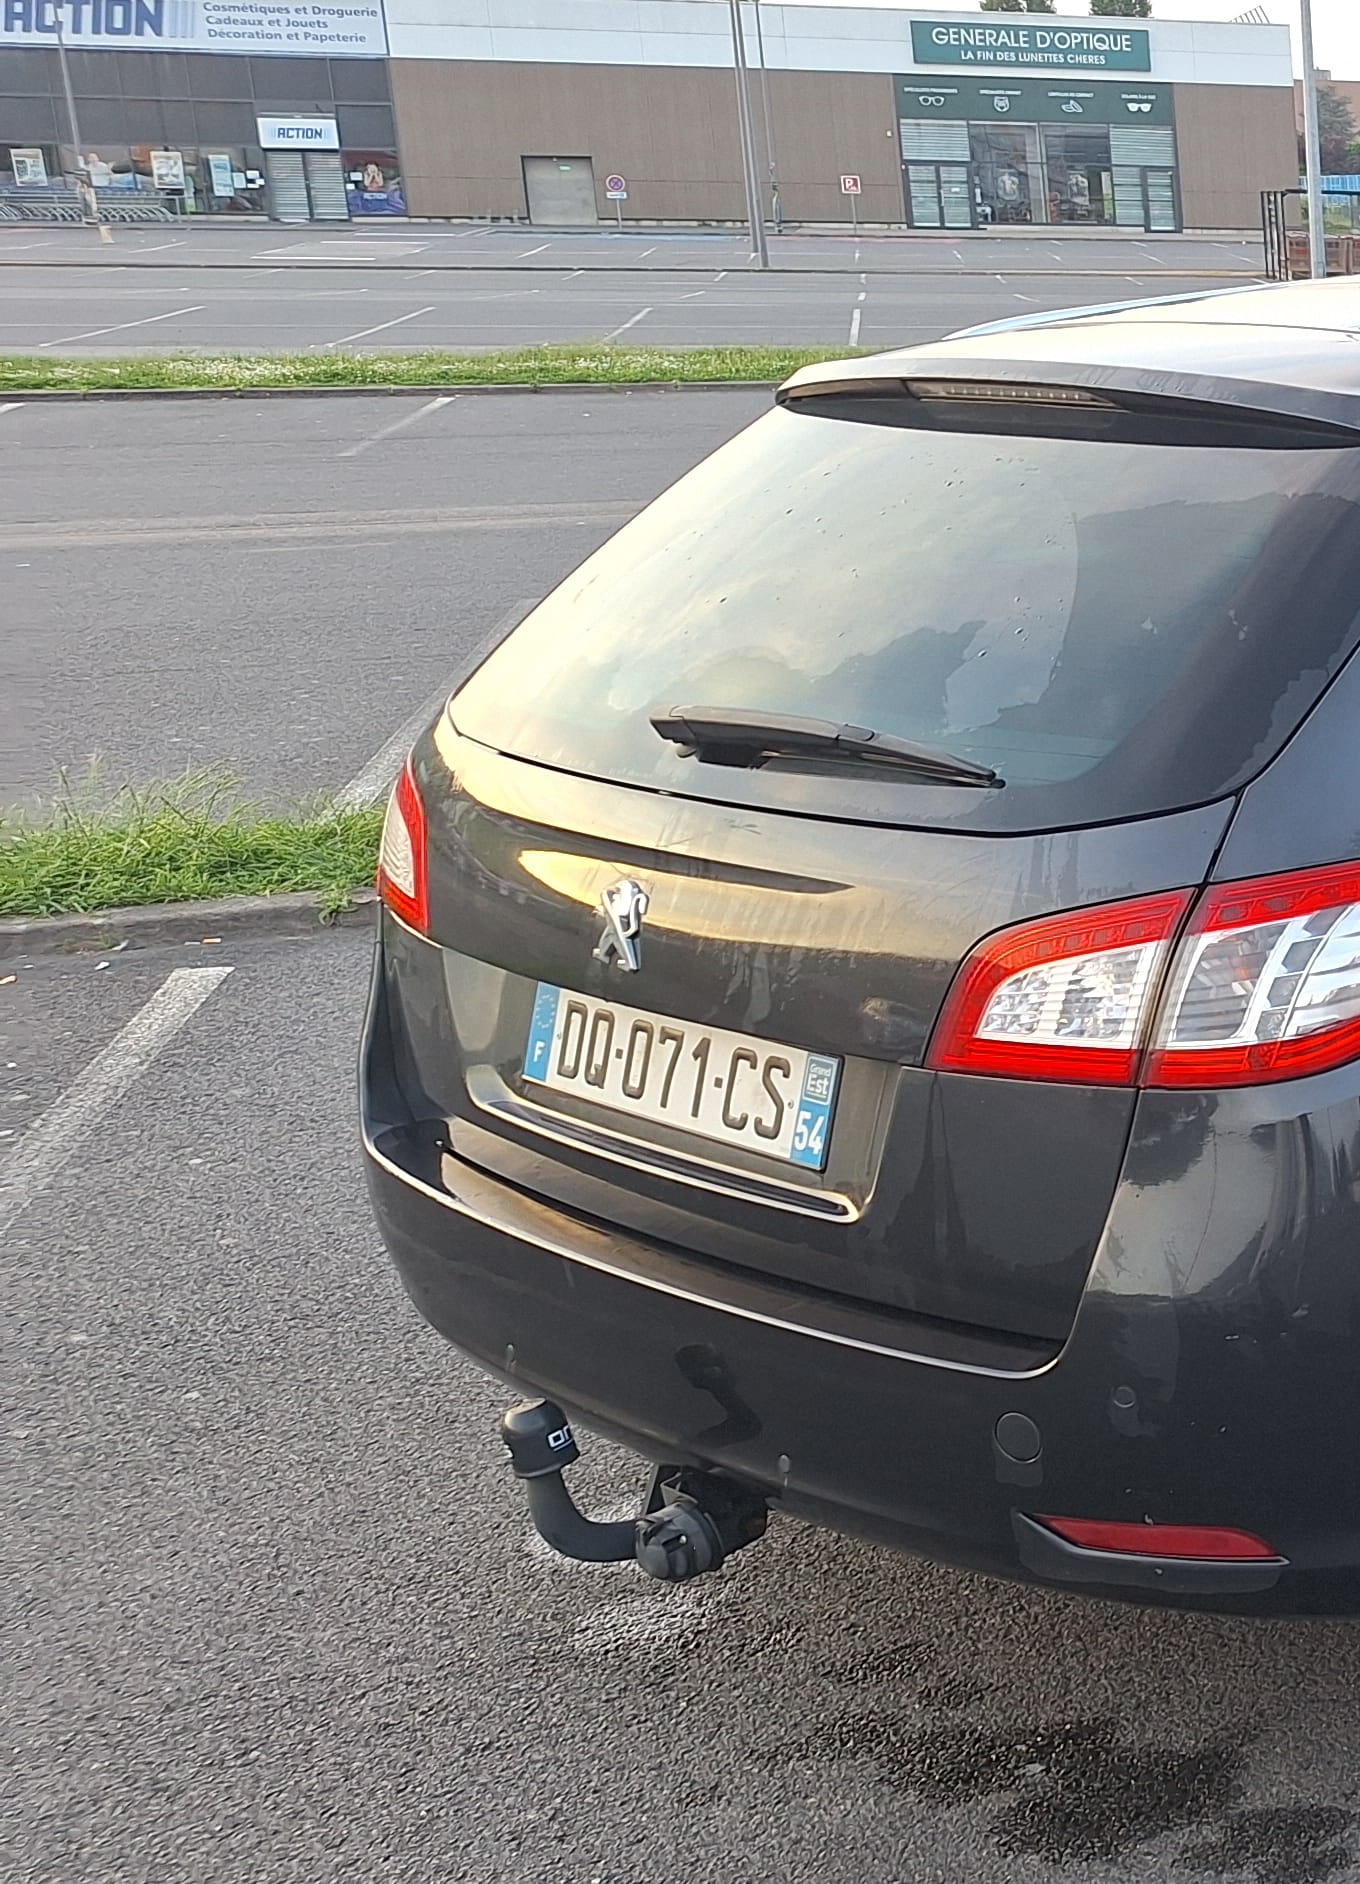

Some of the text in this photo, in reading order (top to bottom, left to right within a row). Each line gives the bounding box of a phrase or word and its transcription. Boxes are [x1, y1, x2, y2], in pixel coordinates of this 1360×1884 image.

[4, 0, 164, 36] ACTION
[203, 2, 378, 18] Cosmétiques et Droguerie
[205, 15, 329, 28] Cadeaux et Jouets
[208, 28, 367, 43] Décoration et Papeterie
[932, 27, 1132, 52] GENERALE D'OPTIQUE
[961, 50, 1106, 64] LA FIN DES LUNETTES CHERES
[277, 127, 323, 139] ACTION
[532, 1040, 546, 1062] F
[809, 1063, 831, 1078] Grand
[807, 1074, 829, 1095] Est
[794, 1112, 824, 1155] 54
